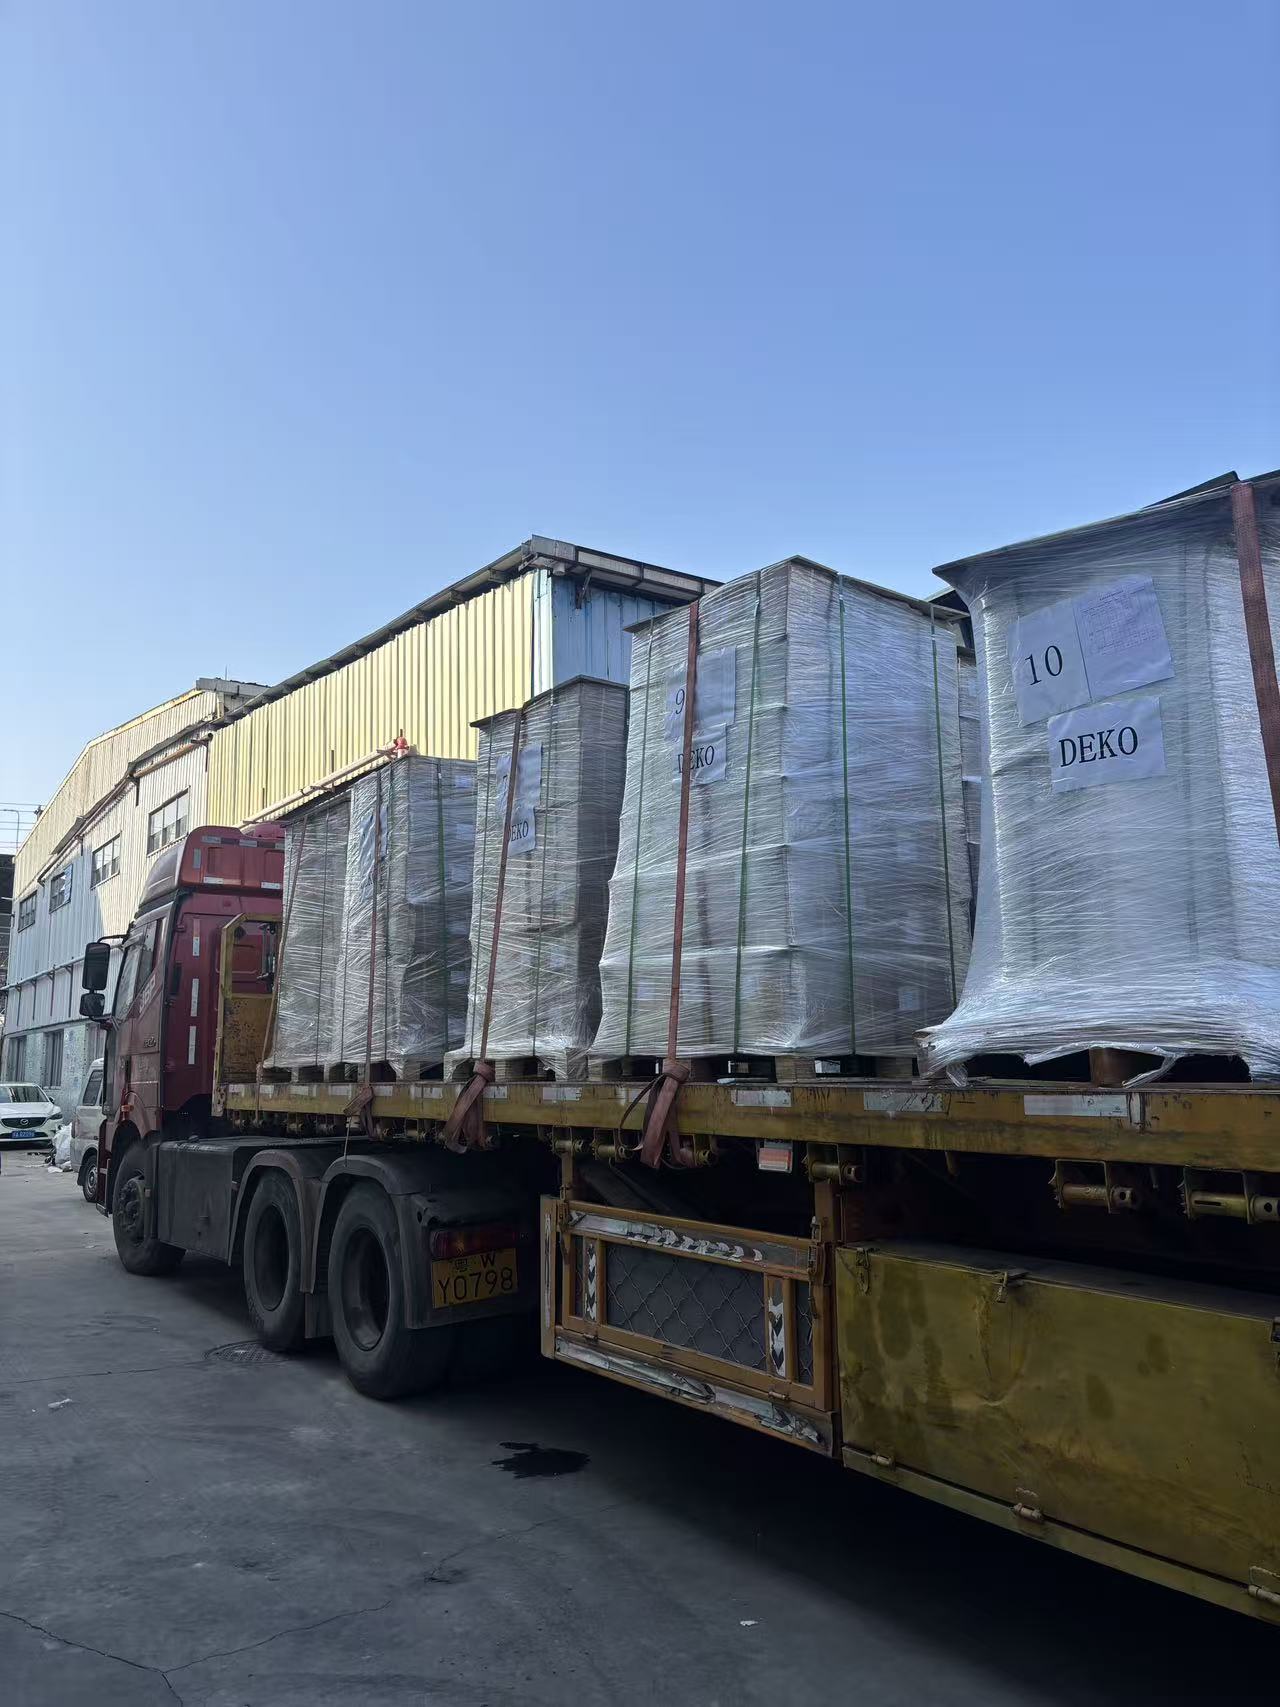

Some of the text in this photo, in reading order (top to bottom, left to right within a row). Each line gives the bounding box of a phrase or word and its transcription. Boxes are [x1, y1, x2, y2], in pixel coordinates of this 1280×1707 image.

[1025, 645, 1063, 686] 10
[675, 688, 685, 715] 9
[1059, 726, 1139, 768] DEKO
[509, 820, 529, 842] EKO
[480, 1253, 496, 1269] W
[438, 1267, 513, 1304] Y0798
